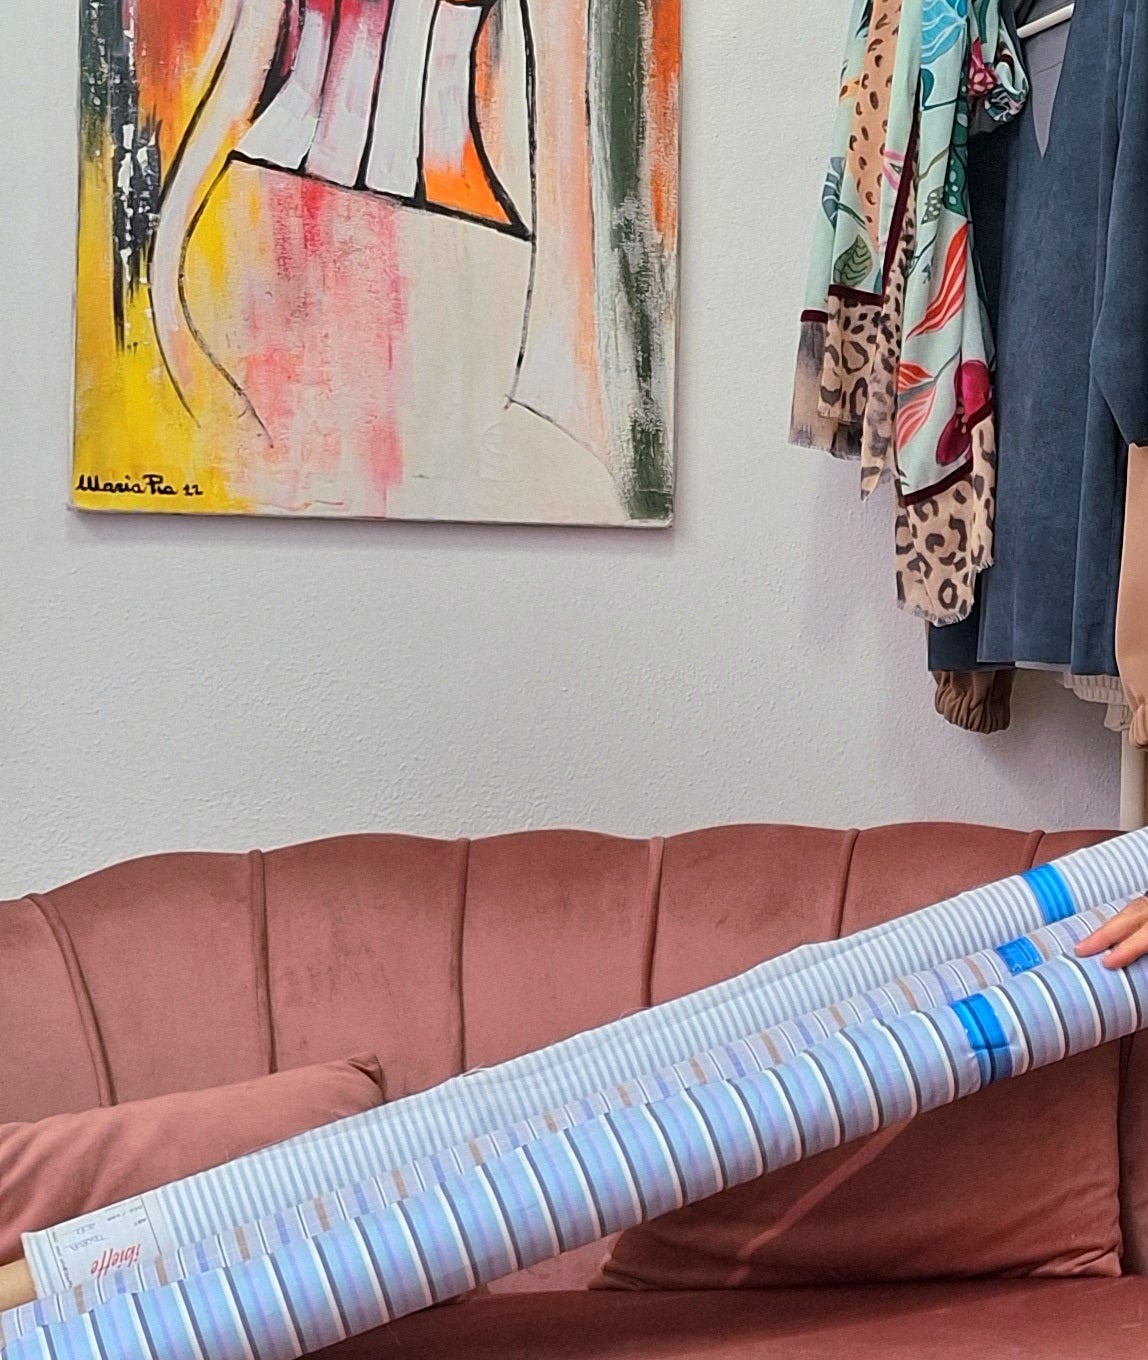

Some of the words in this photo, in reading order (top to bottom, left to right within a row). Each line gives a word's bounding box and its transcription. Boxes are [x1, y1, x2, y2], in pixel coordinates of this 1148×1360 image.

[75, 474, 146, 494] Maria
[142, 473, 178, 495] Pia
[90, 1243, 141, 1278] ibieffe
